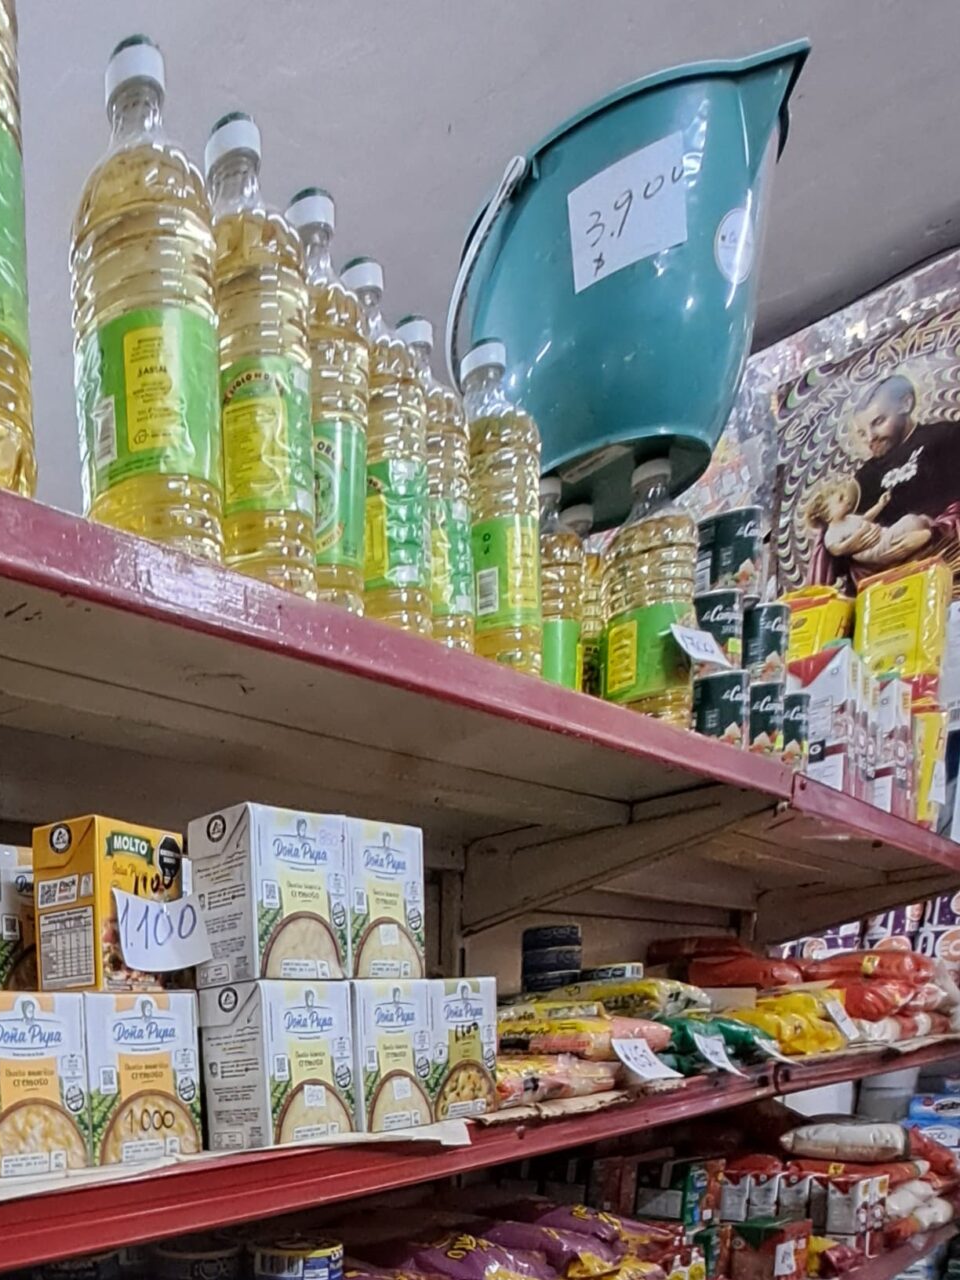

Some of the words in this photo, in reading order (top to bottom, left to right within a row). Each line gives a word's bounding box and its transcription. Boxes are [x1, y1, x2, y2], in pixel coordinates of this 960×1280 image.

[113, 834, 149, 855] MOLTO
[273, 838, 300, 858] Doña
[119, 898, 197, 951] 1.100
[283, 1010, 308, 1030] Doña
[374, 1008, 395, 1026] Doña
[443, 1002, 464, 1019] Doña
[28, 1023, 63, 1048] Pupa
[112, 1021, 144, 1042] Doña
[145, 1021, 176, 1046] Pupa
